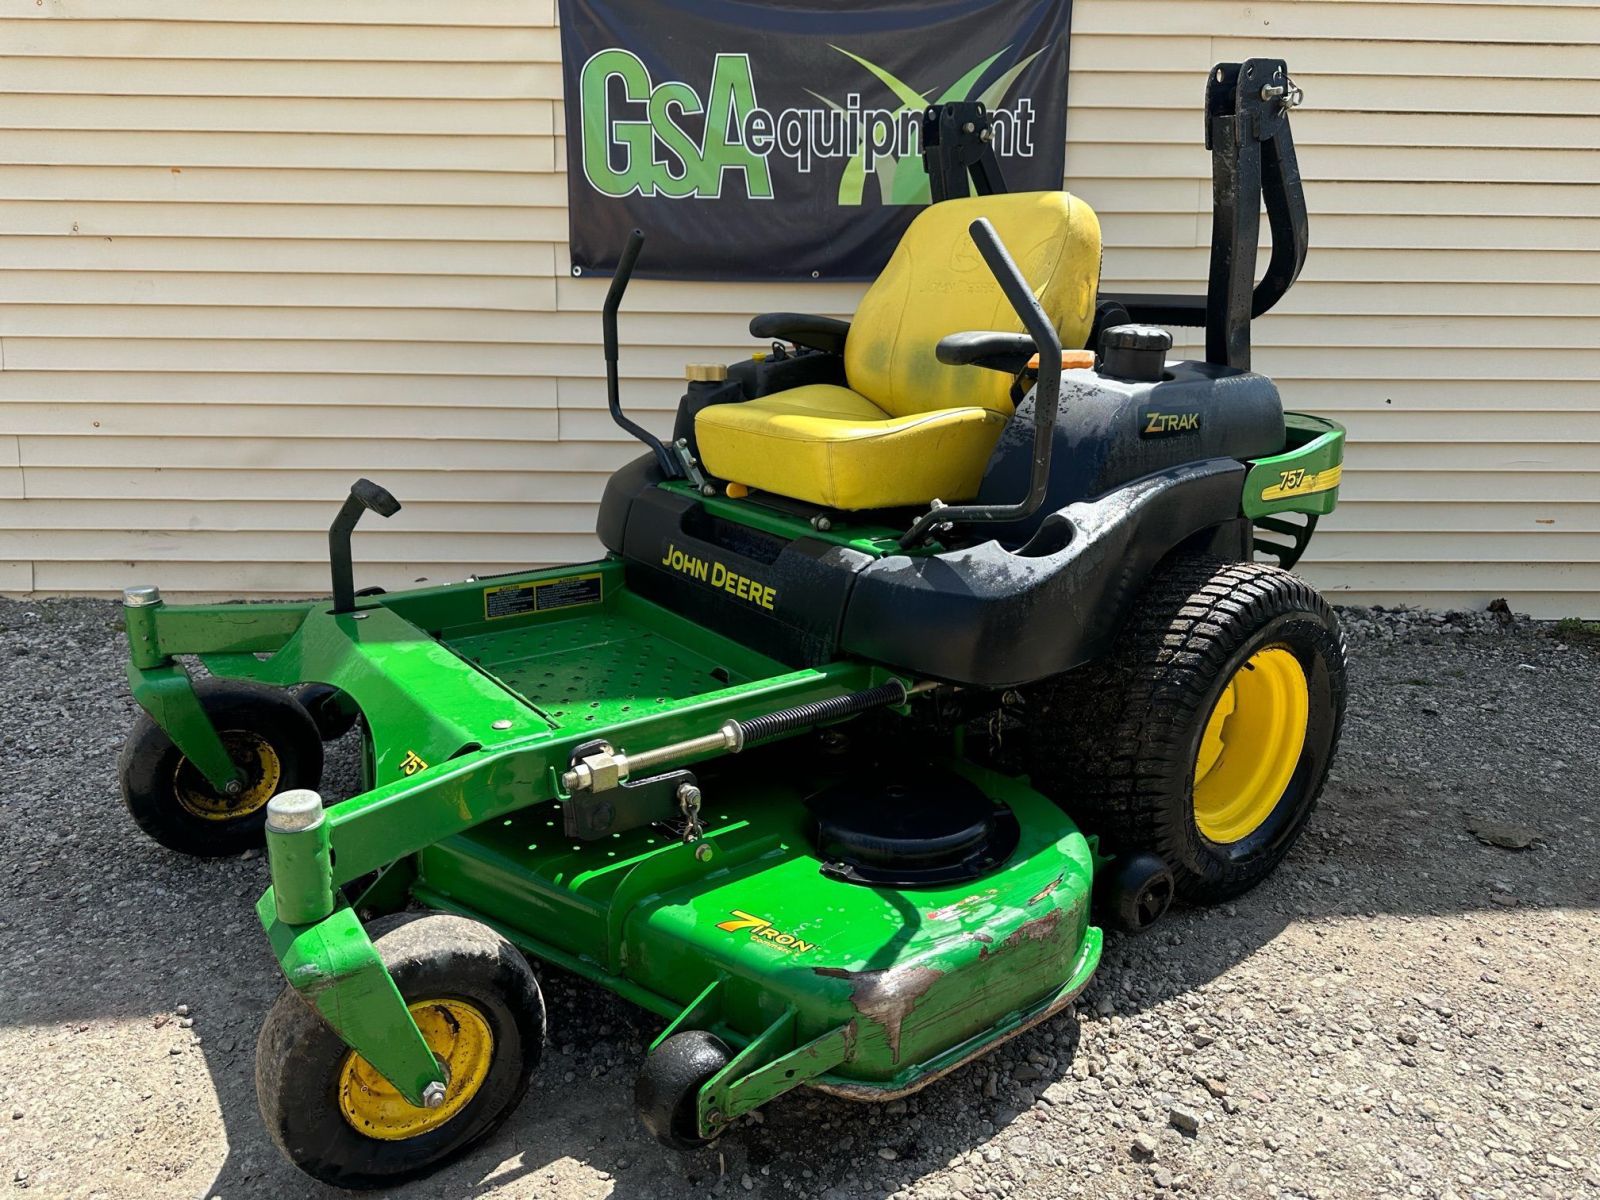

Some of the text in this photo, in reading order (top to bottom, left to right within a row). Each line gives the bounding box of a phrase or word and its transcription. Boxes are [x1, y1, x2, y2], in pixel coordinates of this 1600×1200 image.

[743, 93, 1036, 173] equipmnt
[1145, 412, 1199, 433] ZTRAK
[1279, 468, 1305, 490] 757
[662, 543, 777, 610] JOHN DEERE
[399, 750, 429, 777] 757
